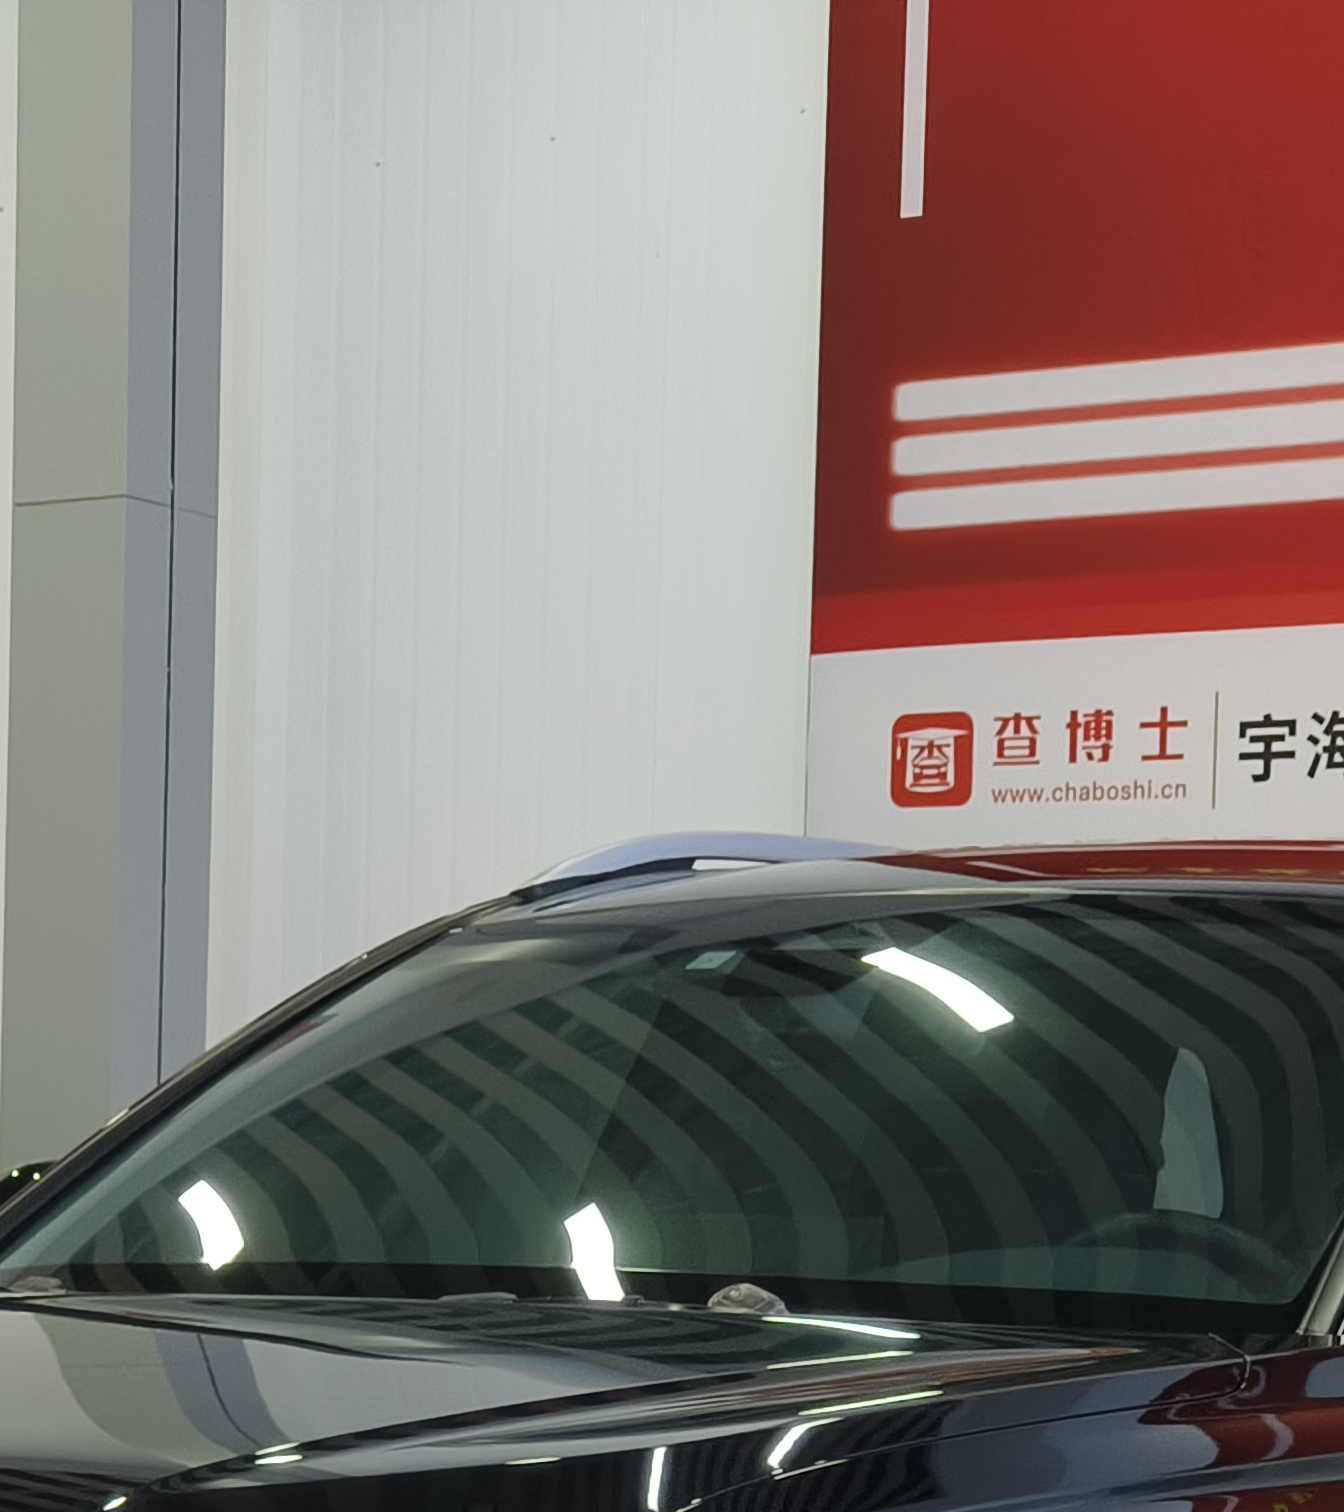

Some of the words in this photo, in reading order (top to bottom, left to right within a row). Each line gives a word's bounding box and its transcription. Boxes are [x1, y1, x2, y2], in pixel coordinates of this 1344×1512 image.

[992, 706, 1189, 767] 查博士
[991, 778, 1188, 805] www.chaboshi.cn
